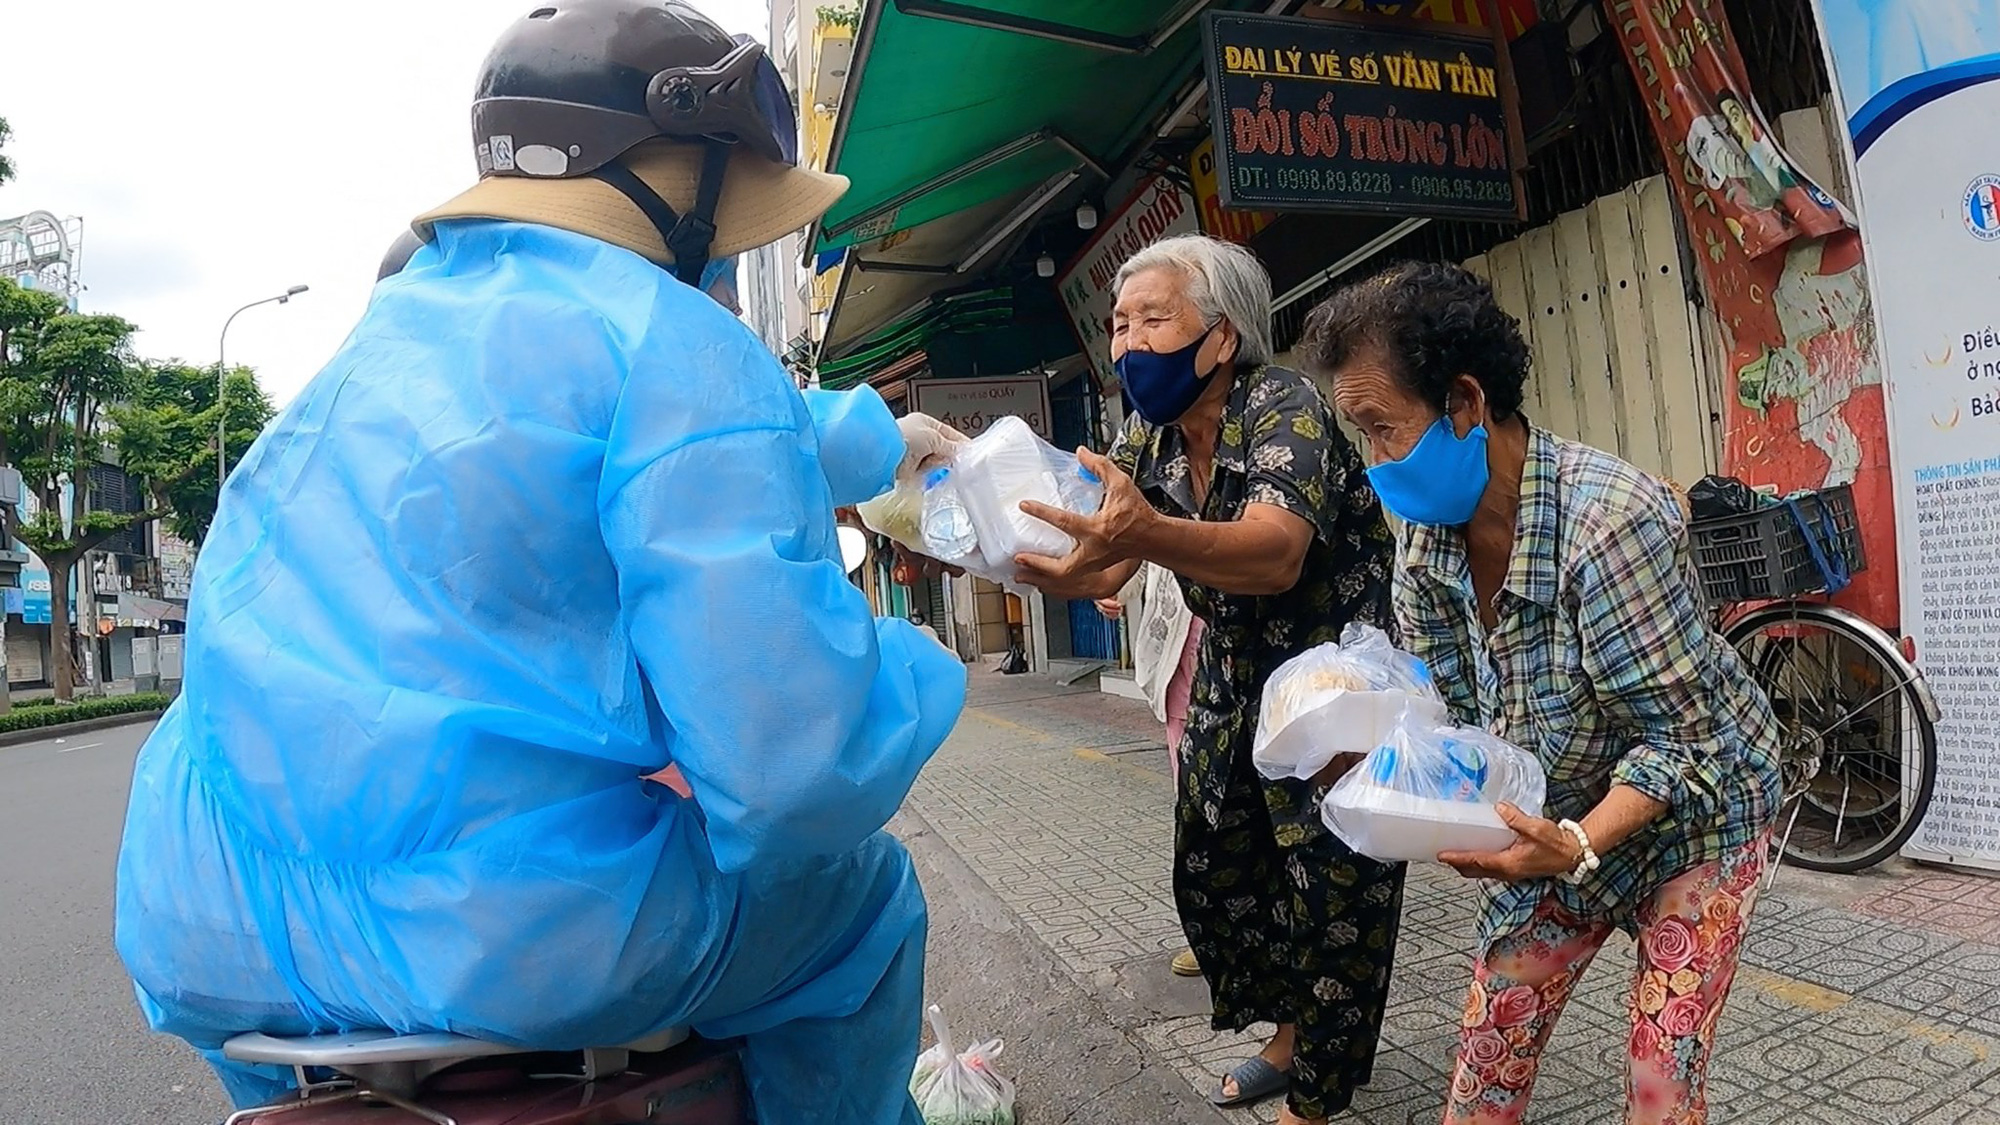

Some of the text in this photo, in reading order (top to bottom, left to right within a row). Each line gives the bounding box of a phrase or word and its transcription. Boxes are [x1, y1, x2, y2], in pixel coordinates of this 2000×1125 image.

[1225, 46, 1266, 78] ĐẠI
[1274, 46, 1303, 73] LÝ
[1310, 50, 1342, 77] VÉ
[1350, 51, 1379, 81] SỐ
[1382, 50, 1442, 92] VĂN
[1231, 81, 1295, 155] ĐỔI
[1298, 91, 1341, 158] SỐ
[1277, 168, 1393, 194] 0908.89.8228
[1967, 360, 1978, 382] ở
[962, 411, 983, 430] SỐ
[1915, 465, 1945, 482] THÔNG
[1946, 463, 1962, 478] TIN
